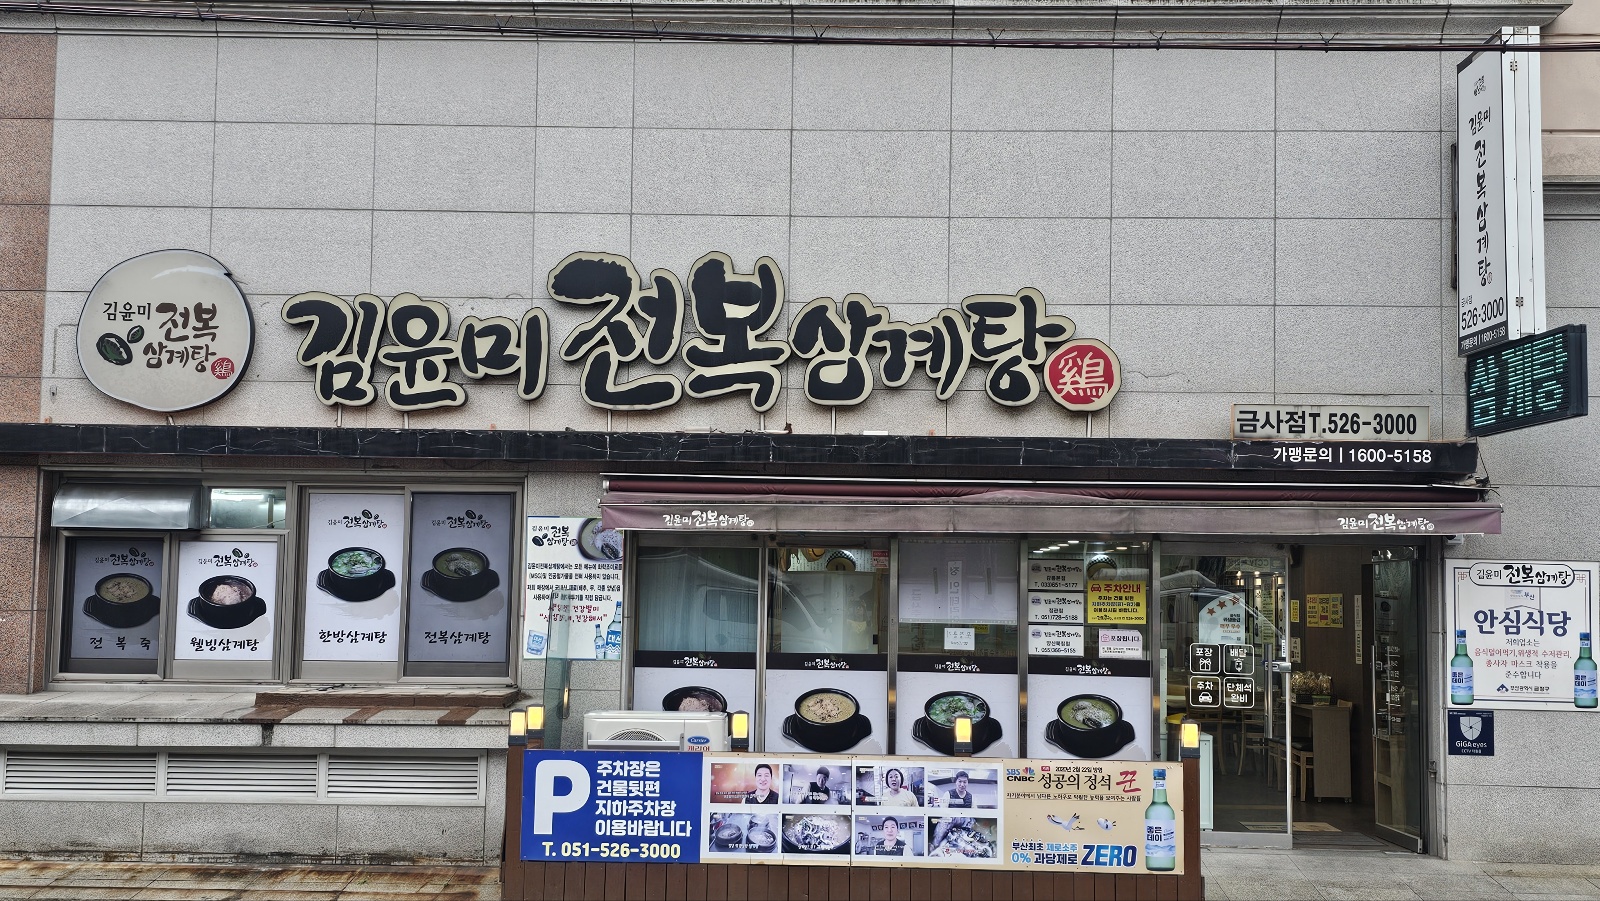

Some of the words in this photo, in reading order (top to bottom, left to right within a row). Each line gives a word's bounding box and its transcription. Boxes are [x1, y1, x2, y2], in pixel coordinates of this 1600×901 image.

[1468, 106, 1492, 136] 김윤미
[1473, 139, 1491, 288] 전복삼계탕
[102, 302, 151, 322] 김윤미
[155, 302, 219, 342] 전복
[287, 299, 544, 407] 김윤미
[551, 254, 1073, 406] 전복삼계탕
[143, 342, 216, 375] 삼계탕
[1470, 334, 1567, 427] 삼계탕
[1273, 447, 1333, 463] 가맹문의
[1349, 449, 1432, 463] 1600-5158
[343, 515, 385, 529] 전복삼계탕
[446, 515, 488, 529] 전복삼계탕
[663, 514, 692, 526] 김윤미
[692, 510, 749, 527] 전복삼계탕
[1337, 517, 1369, 529] 김윤미
[1368, 513, 1430, 531] 전복삼계탕
[550, 525, 570, 538] 전복
[110, 553, 151, 567] 전복삼계탕
[213, 554, 254, 568] 전복삼계탕
[1476, 569, 1502, 580] 김윤미
[1503, 564, 1571, 585] 전복삼계탕
[1104, 584, 1141, 593] 주차안내
[1523, 592, 1535, 600] 부산
[1473, 609, 1572, 637] 안심식당
[190, 636, 260, 651] 웰빙삼계탕
[319, 629, 388, 644] 한방삼계탕
[425, 630, 491, 645] 전복삼계탕
[1196, 648, 1213, 657] 포장
[1230, 649, 1248, 658] 배달
[1486, 660, 1508, 668] 종사자
[1511, 660, 1533, 668] 마스크
[1535, 661, 1558, 669] 착용을
[1505, 671, 1542, 679] 준수합니다
[1197, 682, 1213, 690] 주차
[1226, 683, 1252, 692] 단체석
[1231, 694, 1248, 703] 완비
[597, 760, 661, 777] 주차장은
[1006, 768, 1021, 776] SBS
[597, 780, 661, 797] 건물뒷편
[1038, 773, 1080, 790] 성공의
[1084, 774, 1112, 791] 정석
[1116, 770, 1141, 793] 꾼
[534, 760, 591, 835] P
[595, 800, 677, 817] 지하주차장
[595, 820, 692, 837] 이용바랍니다
[1146, 834, 1163, 842] 데이
[542, 842, 557, 856] T.
[561, 842, 681, 858] 051-526-3000
[1011, 842, 1044, 851] 부산최초
[1046, 843, 1078, 852] 제로소주
[1011, 852, 1031, 863] 0%
[1034, 853, 1078, 865] 과당제로
[1081, 844, 1137, 867] ZERO
